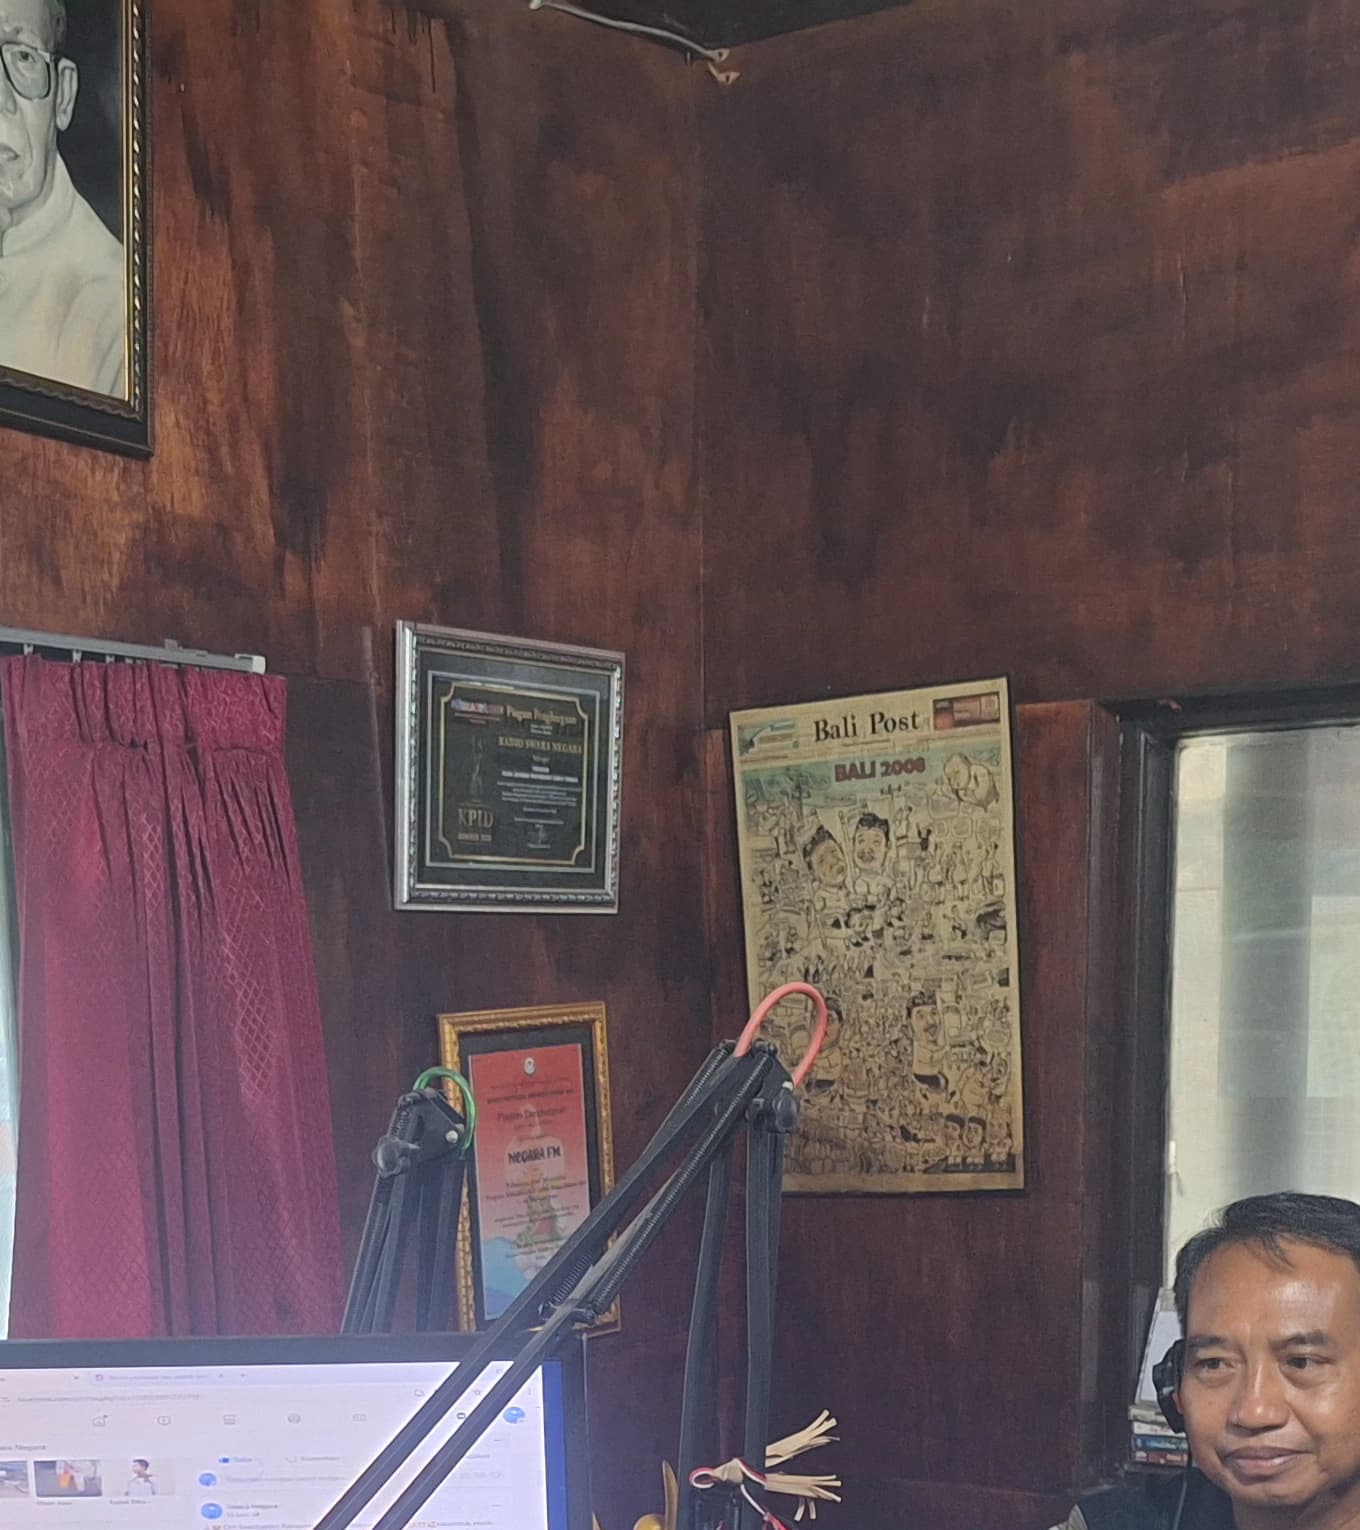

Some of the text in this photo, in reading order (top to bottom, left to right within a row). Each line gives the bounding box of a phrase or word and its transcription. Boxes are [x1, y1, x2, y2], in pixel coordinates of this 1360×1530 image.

[814, 711, 920, 742] Bali Post
[834, 760, 876, 782] BALI
[546, 1146, 561, 1159] FM
